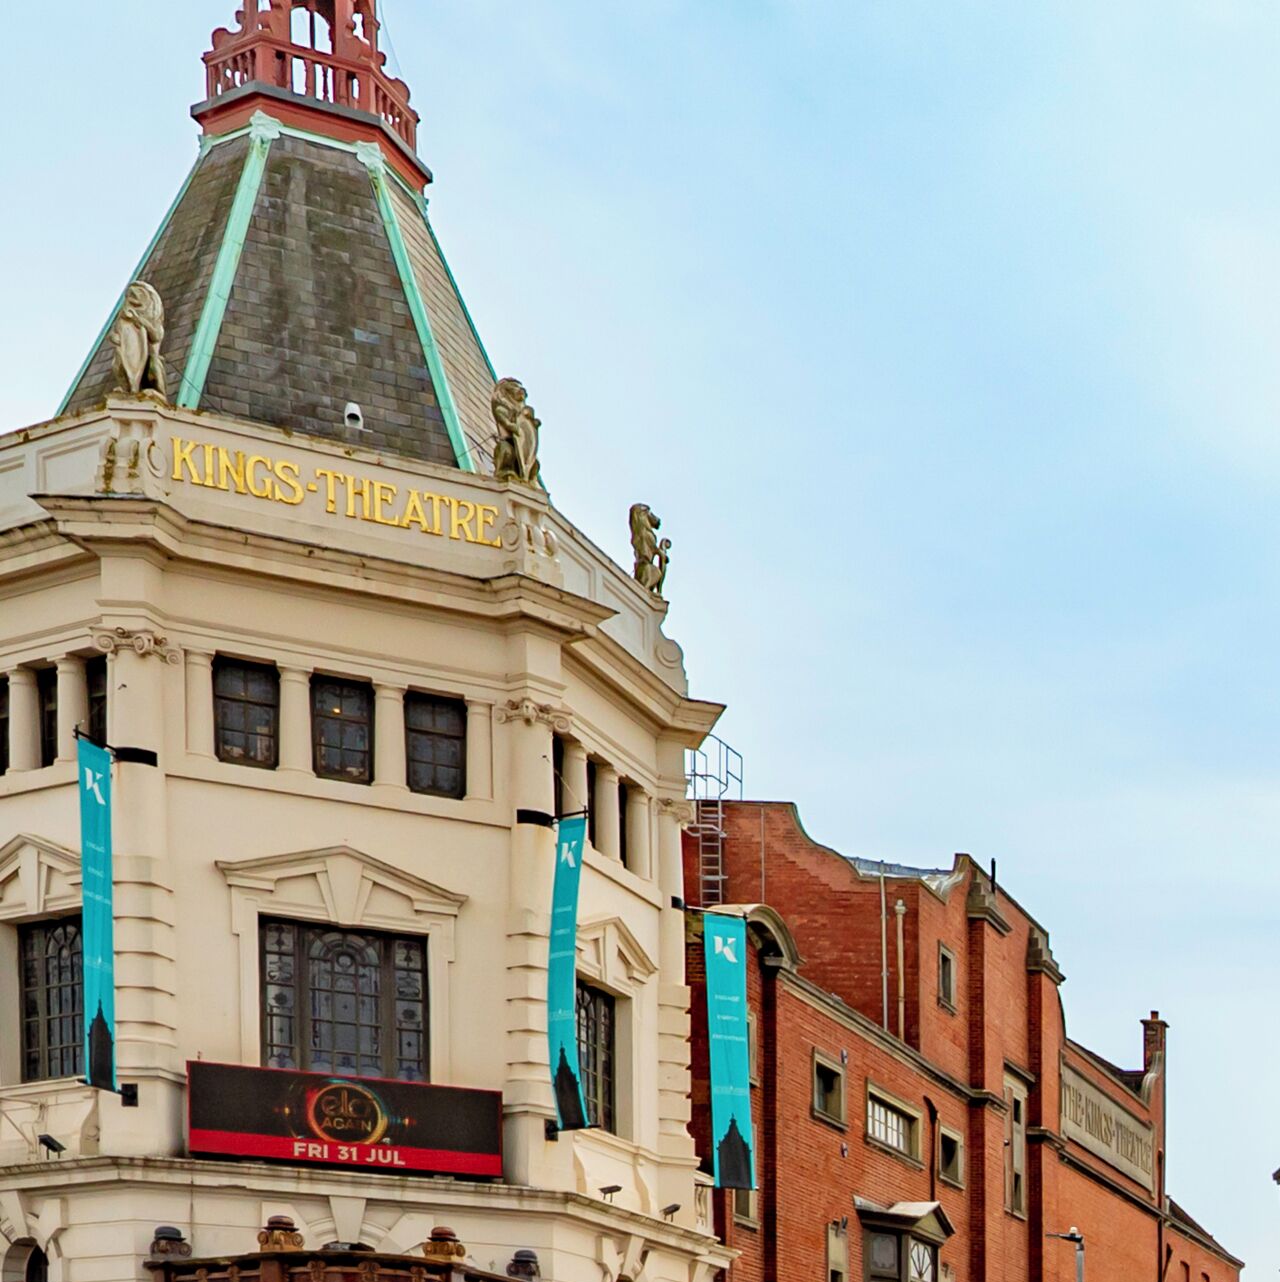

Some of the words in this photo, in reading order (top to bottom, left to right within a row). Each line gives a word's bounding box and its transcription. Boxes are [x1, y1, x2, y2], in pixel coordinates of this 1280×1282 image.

[171, 437, 304, 505] KINGS
[315, 468, 502, 548] THEATRE
[293, 1141, 329, 1158] FRI
[337, 1144, 358, 1161] 31
[365, 1148, 405, 1165] JUL
[321, 1117, 373, 1133] AGAN
[1062, 1082, 1082, 1128] THE
[1085, 1096, 1113, 1148] KINGS
[1115, 1118, 1151, 1176] THEATRE
